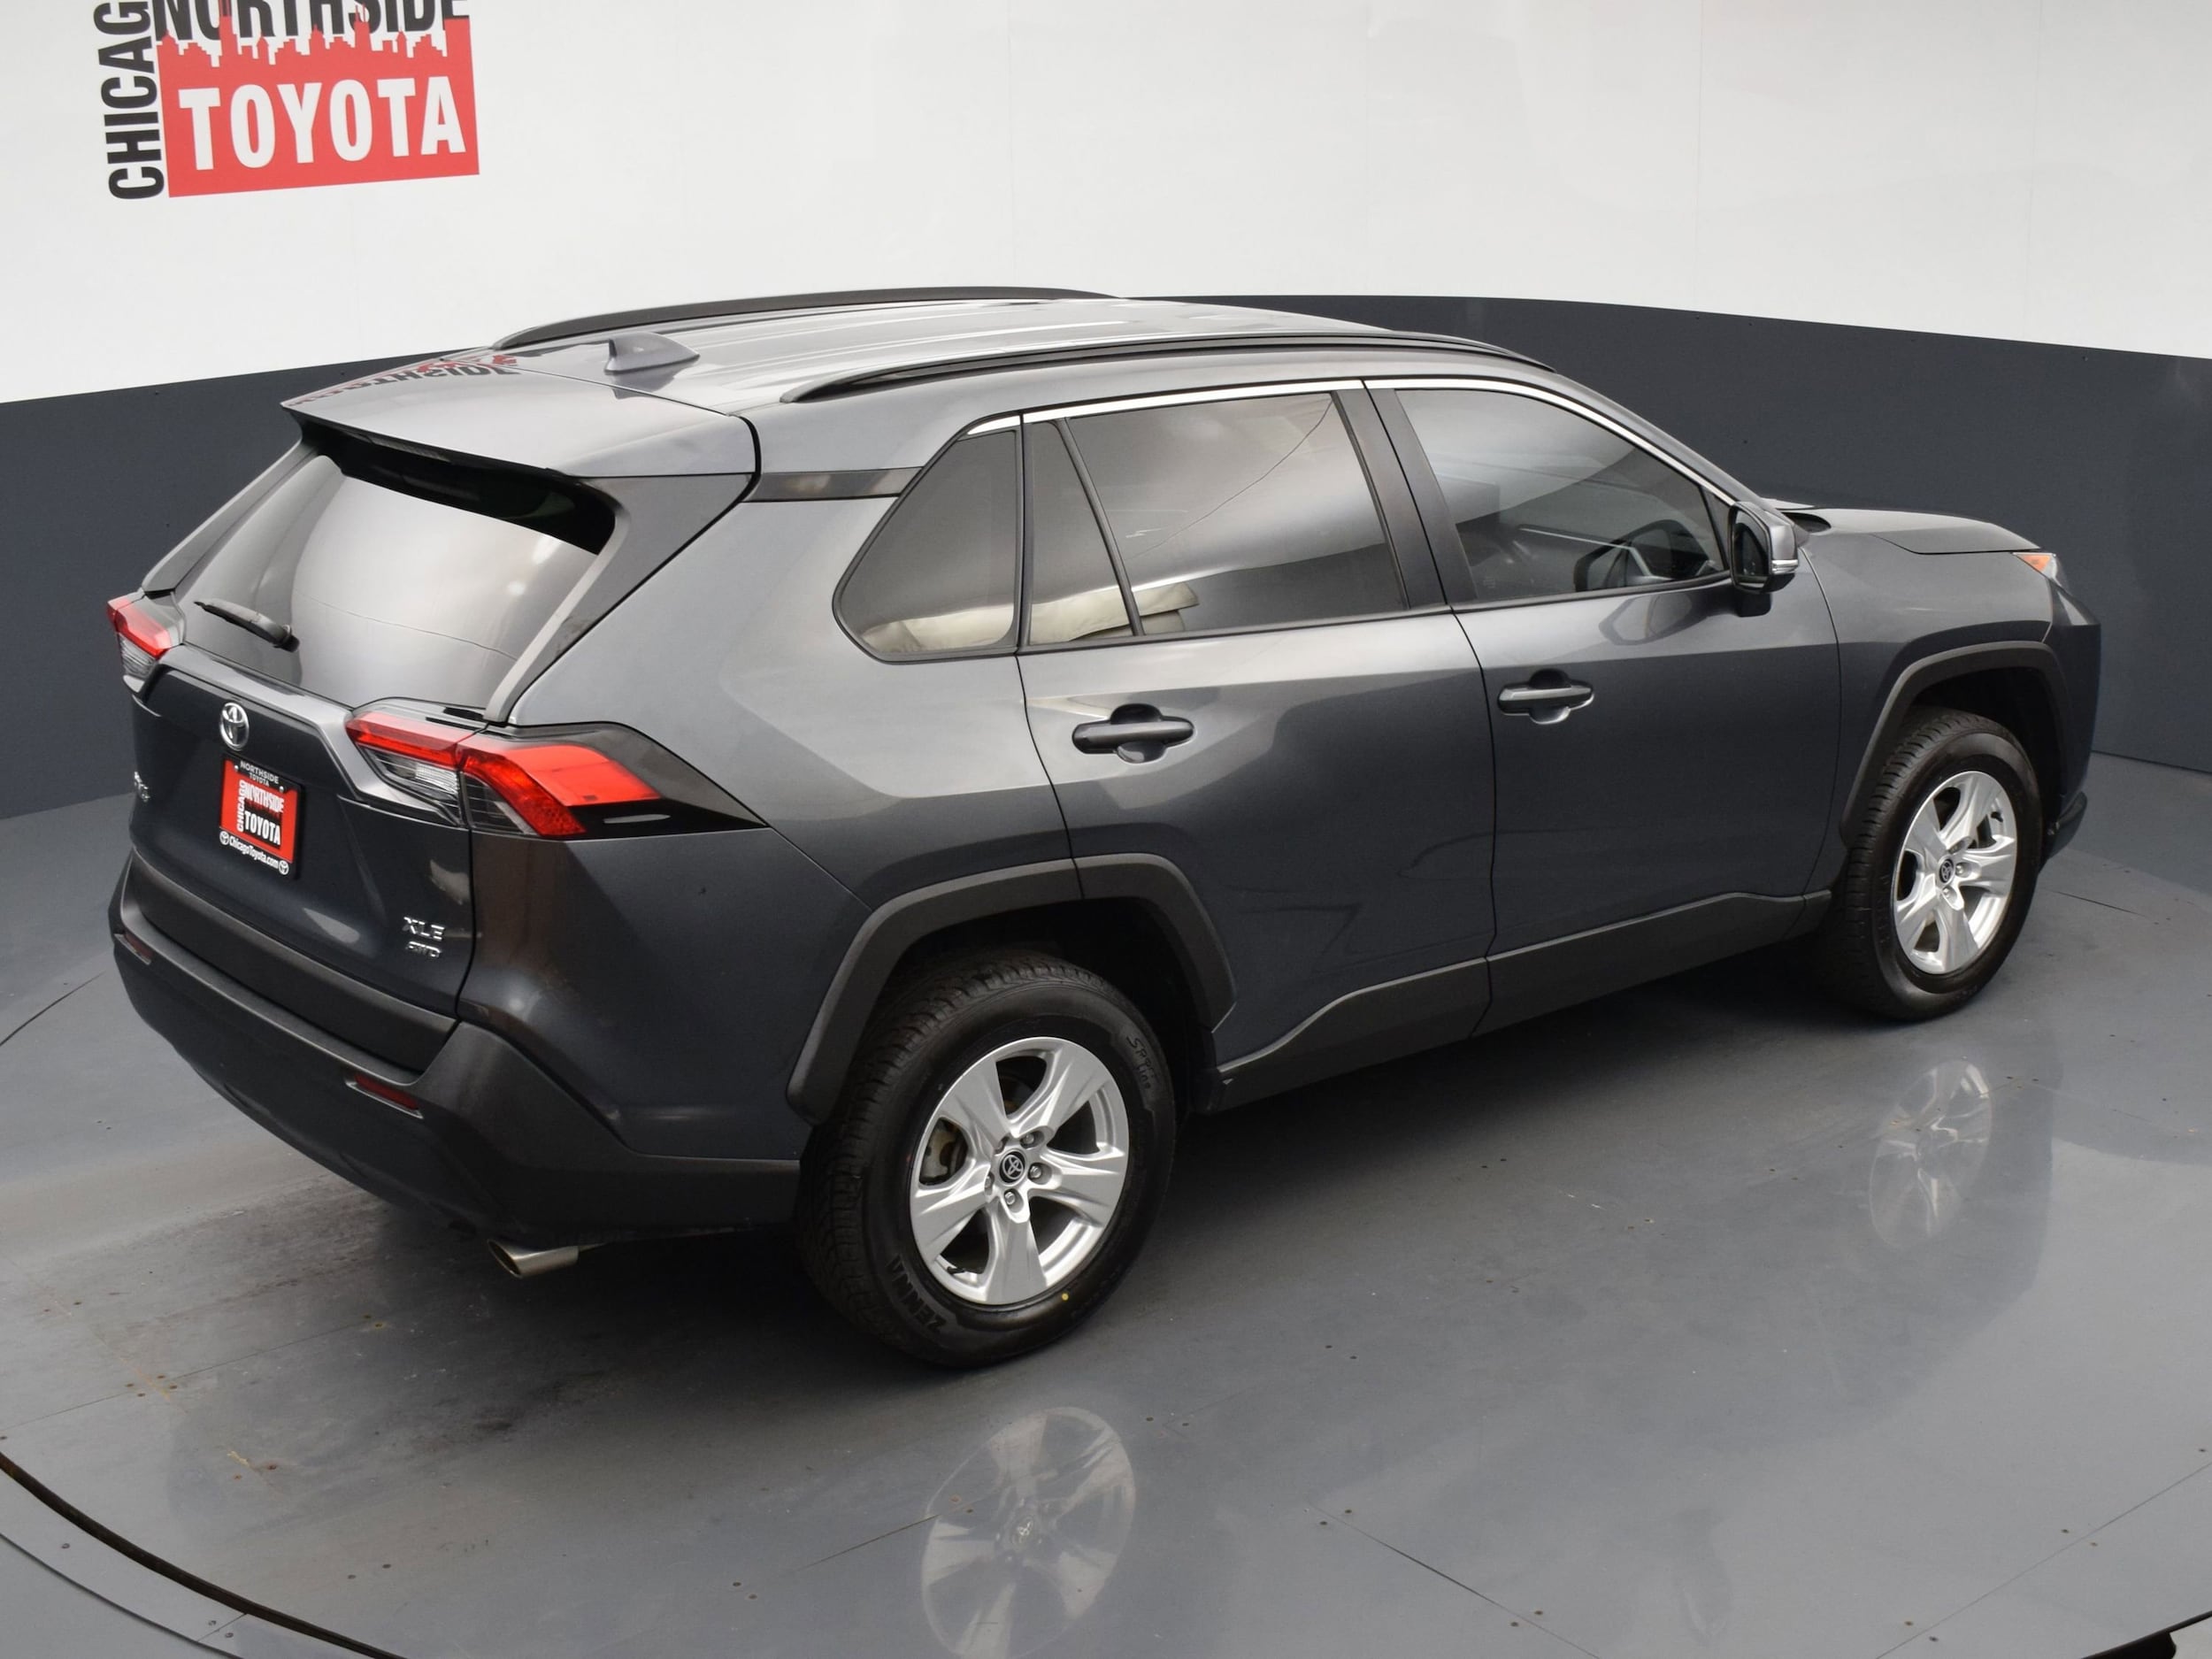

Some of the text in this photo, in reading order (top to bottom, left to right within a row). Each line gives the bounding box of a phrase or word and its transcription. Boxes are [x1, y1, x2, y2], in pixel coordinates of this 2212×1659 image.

[93, 0, 165, 199] CHICAG
[178, 75, 466, 171] TOYOTA
[240, 760, 280, 785] NORTHSIDE
[249, 772, 270, 787] TOYOTA
[236, 780, 247, 833] CHICAGO
[244, 782, 285, 813] NORTHSIDE
[244, 810, 281, 846] TOYOTA
[229, 835, 279, 870] ChicagoToyota.com
[403, 916, 445, 941] XLE
